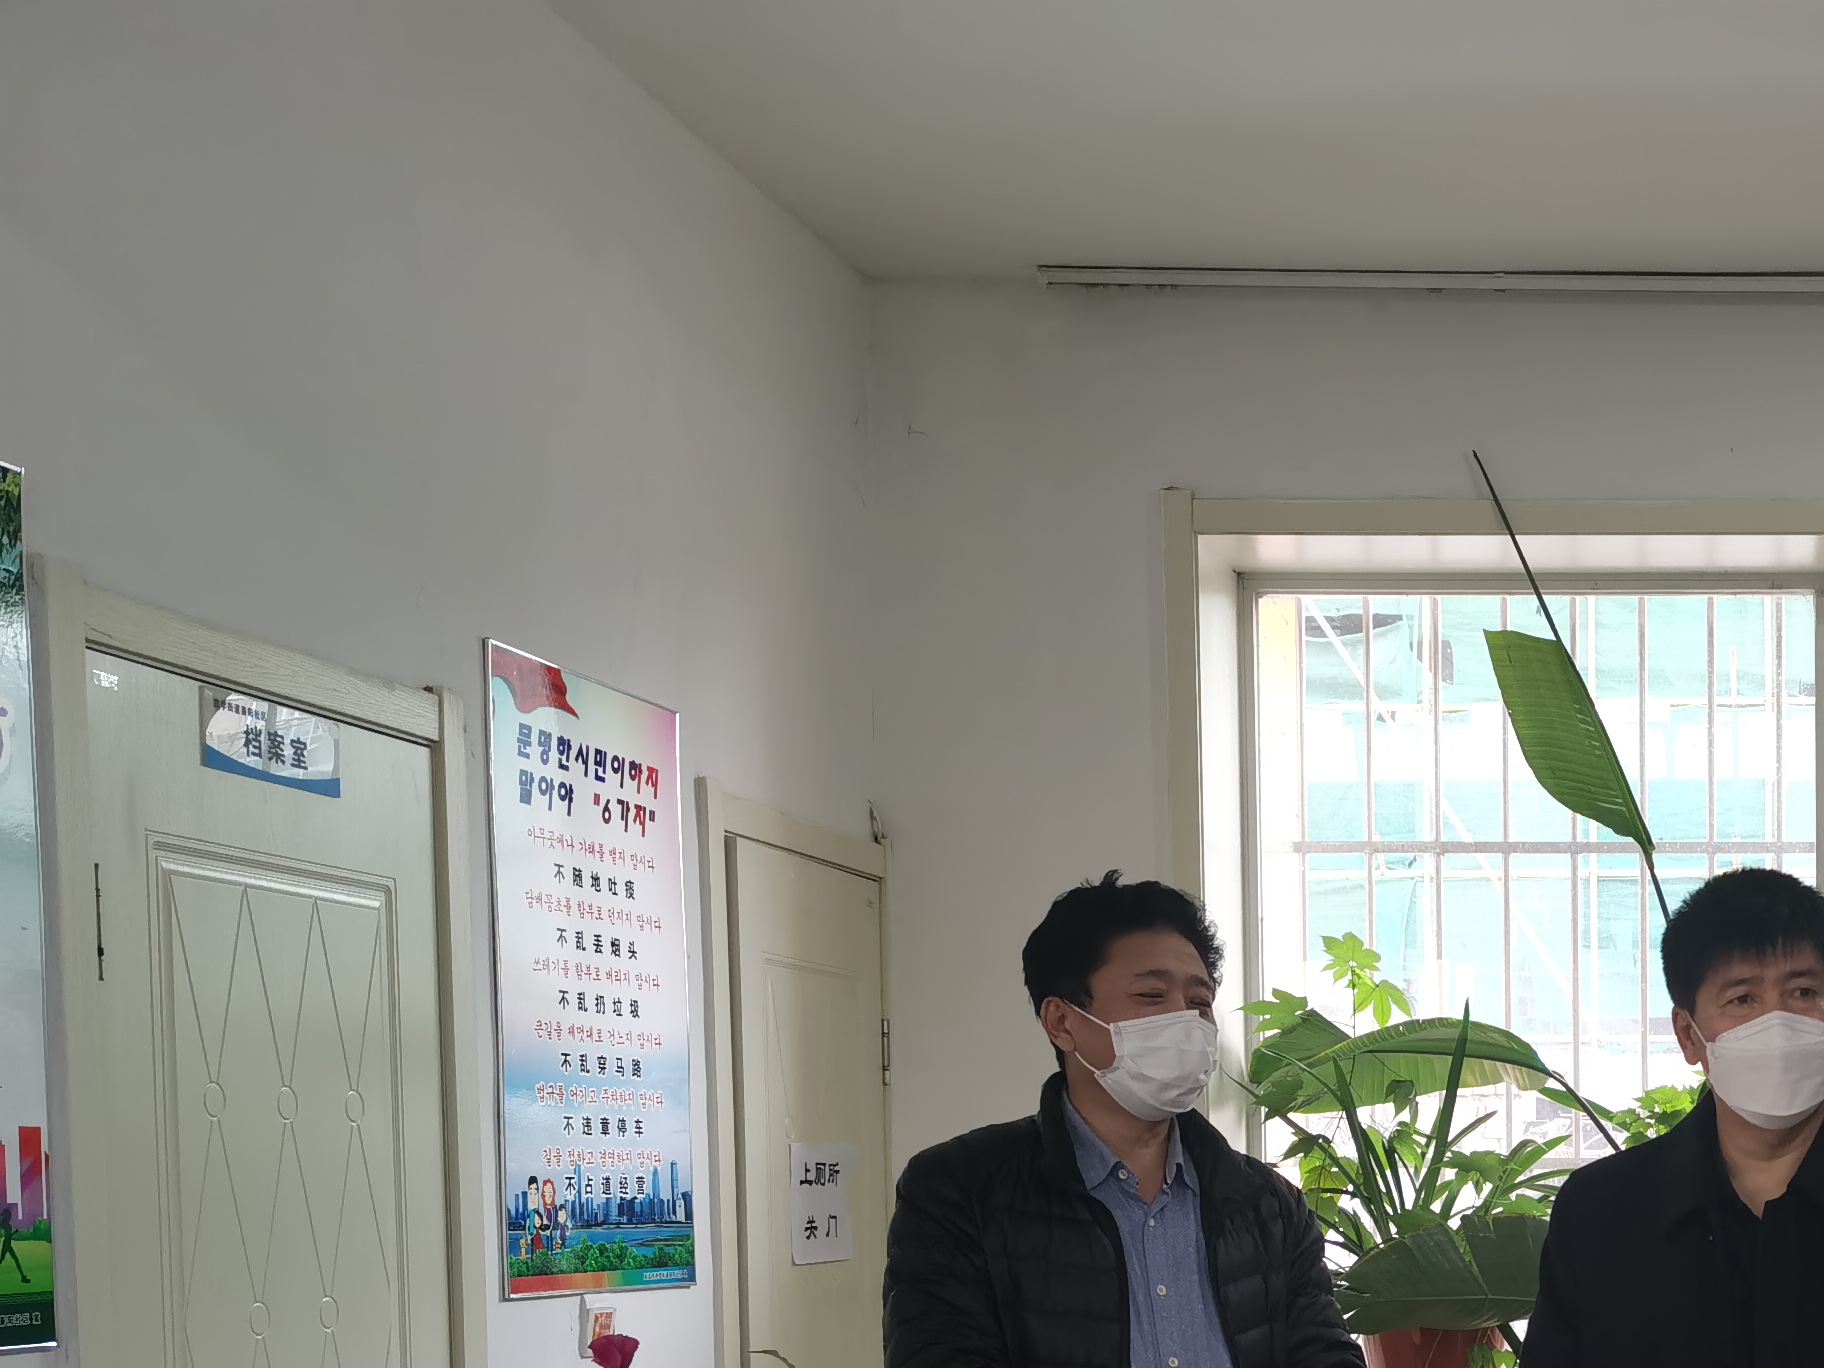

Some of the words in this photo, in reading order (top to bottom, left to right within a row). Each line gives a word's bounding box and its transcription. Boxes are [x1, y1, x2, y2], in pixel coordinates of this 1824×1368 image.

[243, 725, 308, 770] 档案室
[518, 768, 574, 817] 말아야
[553, 862, 636, 901] 不随地吐痰
[576, 900, 604, 921] 함부로
[556, 927, 638, 961] 不乱丢烟头
[532, 956, 570, 979] 쓰레기를
[574, 961, 602, 982] 함부로
[605, 966, 631, 988] 버리지
[558, 989, 641, 1019] 不乱扔垃圾
[560, 1052, 642, 1079] 不乱穿马路
[569, 1086, 598, 1105] 어기고
[563, 1116, 644, 1138] 不违章停车
[543, 1148, 563, 1168] 길을
[564, 1176, 646, 1196] 不占道经营
[800, 1162, 840, 1187] 上厕所
[804, 1214, 838, 1240] 关门
